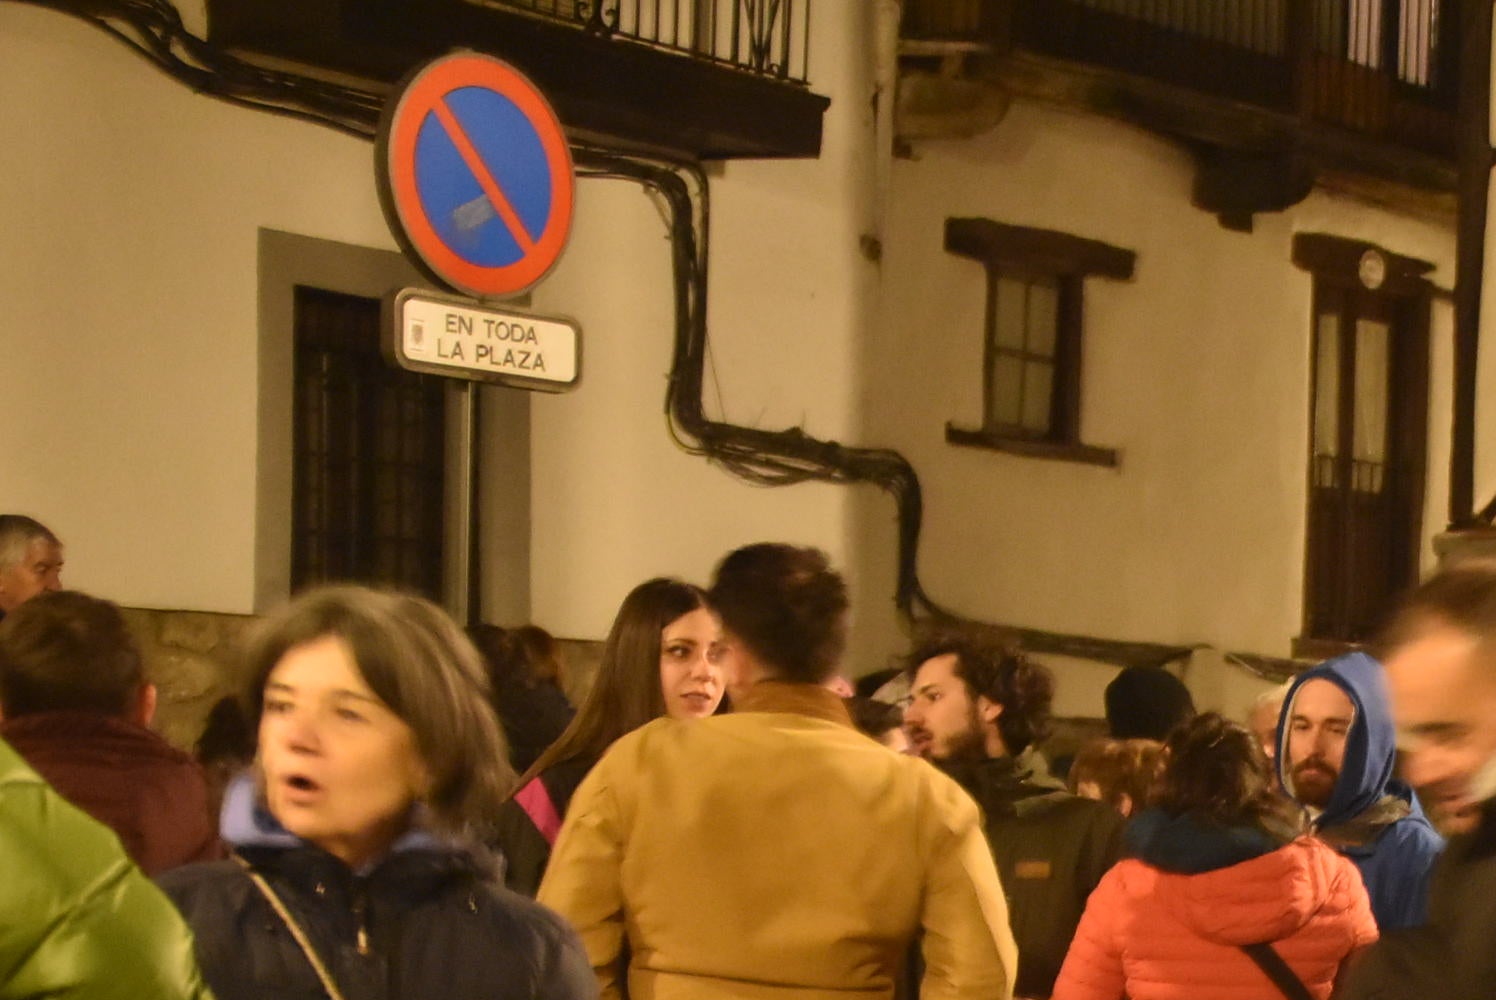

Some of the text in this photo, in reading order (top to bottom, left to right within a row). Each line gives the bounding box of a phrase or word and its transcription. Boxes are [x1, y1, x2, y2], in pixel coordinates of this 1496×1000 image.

[446, 313, 538, 345] EN TODA
[437, 338, 546, 372] LA PLAZA
